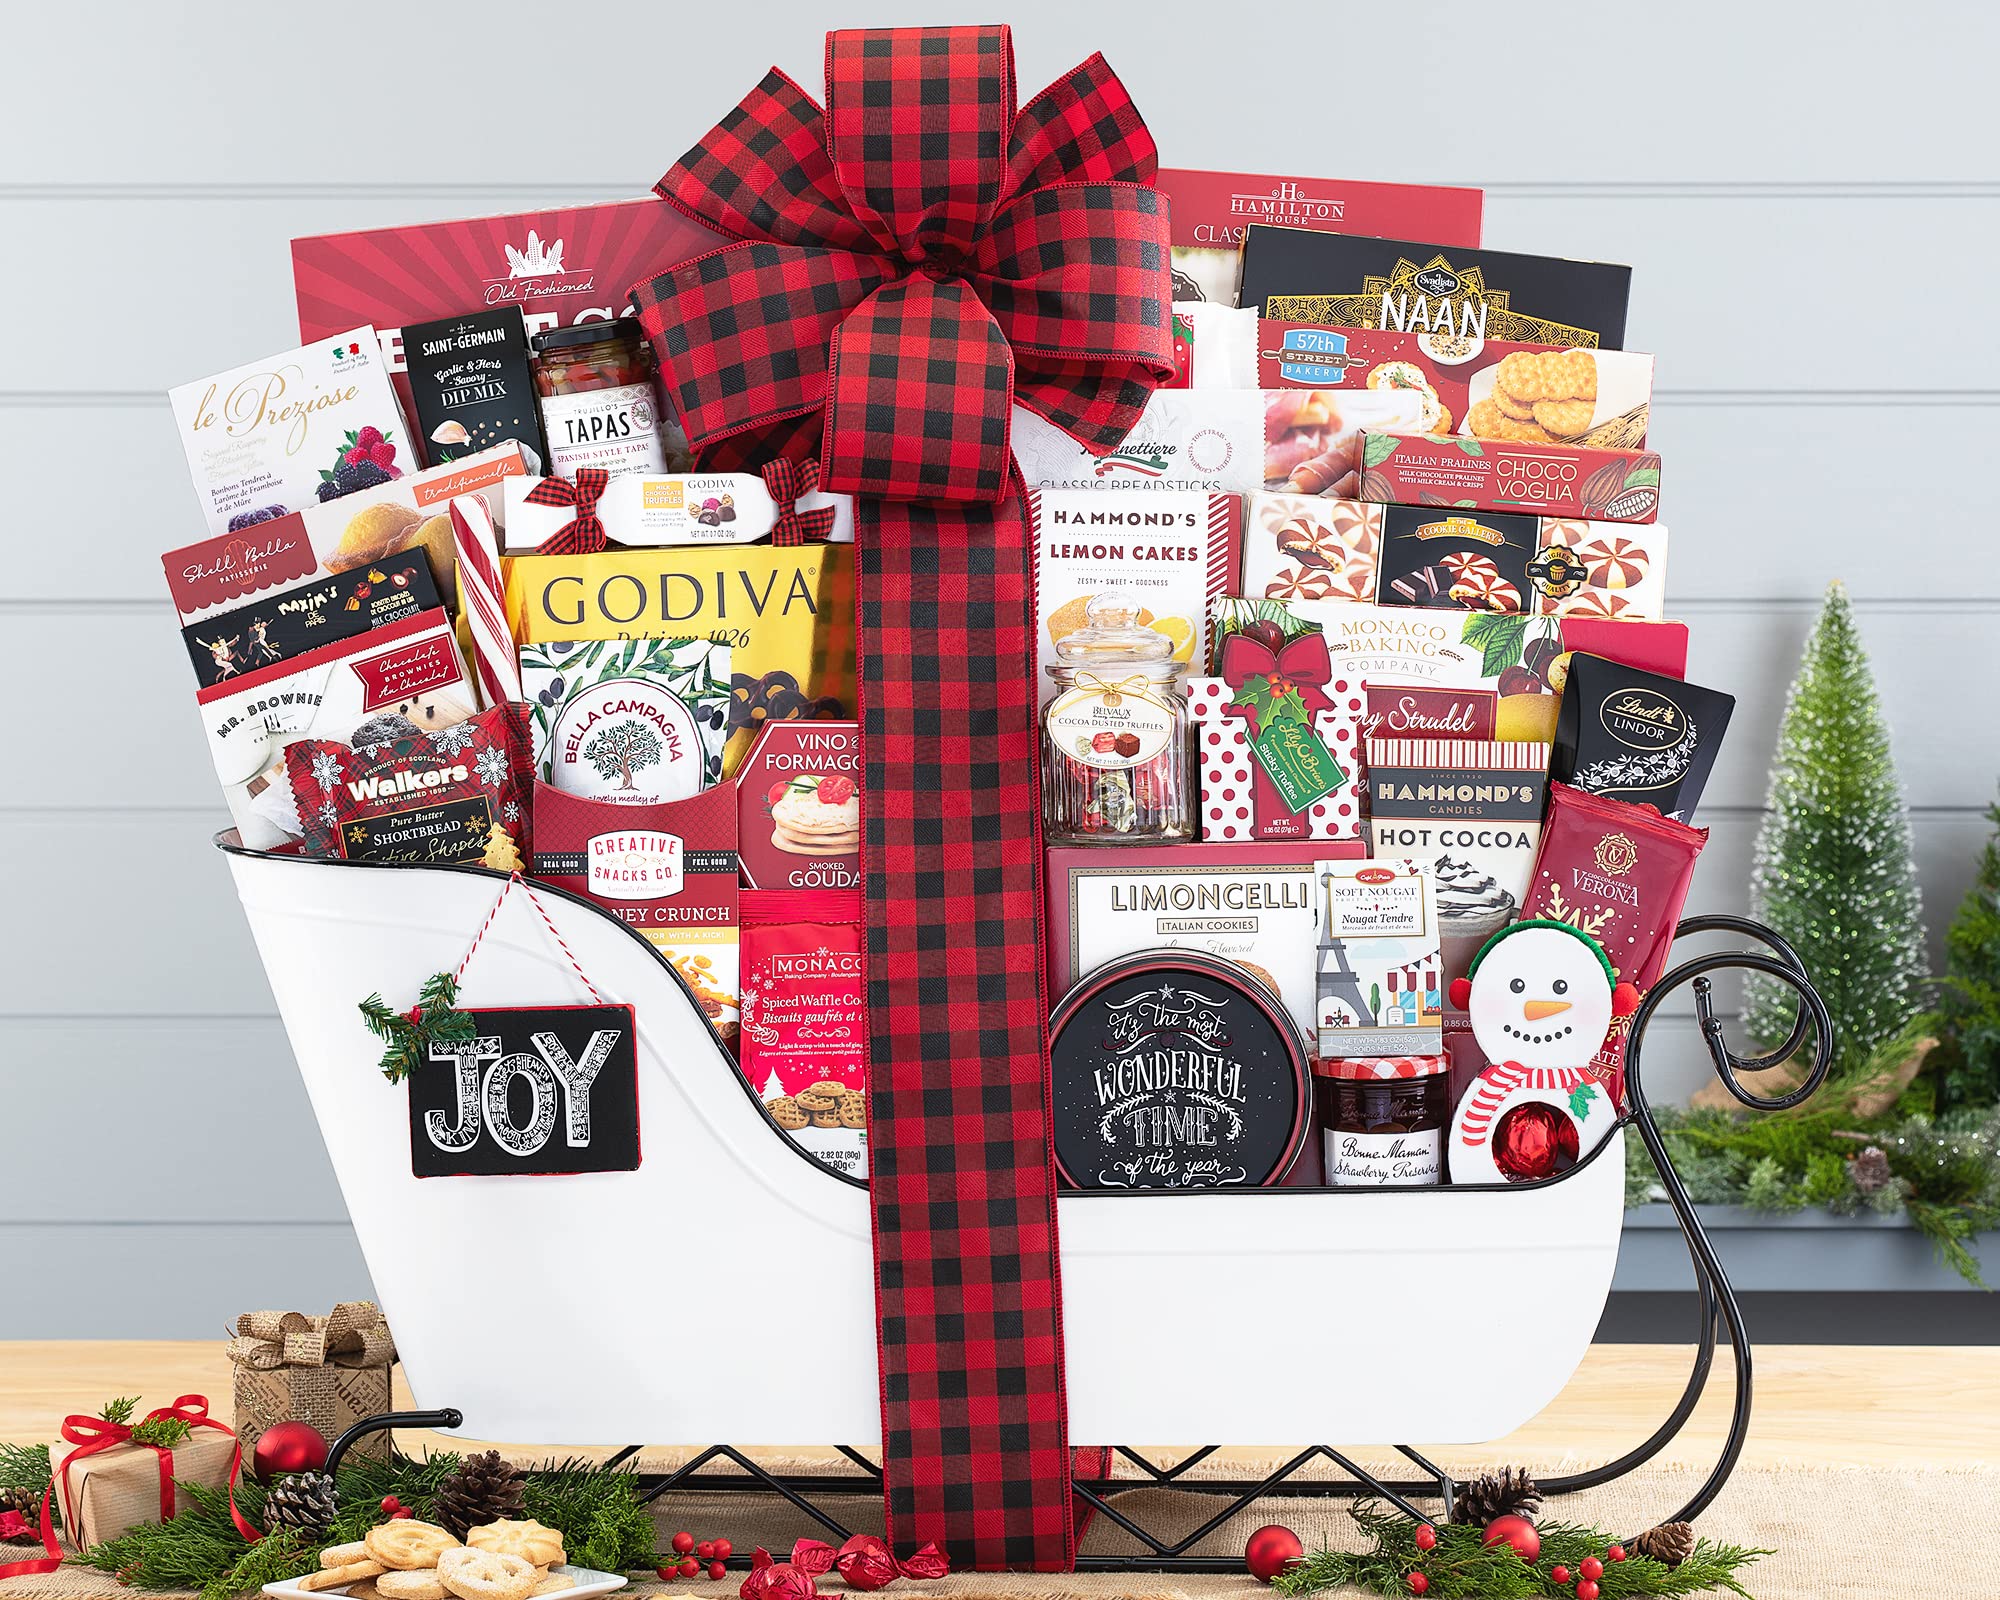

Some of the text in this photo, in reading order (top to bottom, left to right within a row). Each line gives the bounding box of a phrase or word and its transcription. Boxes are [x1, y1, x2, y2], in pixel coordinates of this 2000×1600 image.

[1230, 199, 1345, 219] HAMILTON
[1265, 214, 1308, 225] HOUSE
[484, 276, 595, 305] Old Fashioned
[1381, 290, 1489, 339] NAAN
[422, 327, 507, 356] SAINT-GERMAIN
[1296, 333, 1335, 352] 57th
[1285, 351, 1343, 365] STREET
[433, 357, 502, 384] Garlic Herb
[453, 371, 486, 386] Savory
[1285, 364, 1340, 378] BAKERY
[440, 380, 508, 408] DIP MIX
[193, 364, 360, 457] le Preziose
[573, 403, 619, 415] TRUJILLO'S
[564, 411, 631, 444] TAPAS
[557, 446, 623, 463] SPANISH STYLE
[1394, 454, 1492, 470] ITALIAN PRALINES
[1398, 469, 1486, 482] MILK CHOCOLATE PRALINES
[1495, 458, 1578, 483] CHOCO
[210, 473, 267, 498] Bonbons Tendres
[213, 477, 284, 507] Larôme de Framboise
[687, 478, 736, 490] GODIVA
[1398, 476, 1485, 489] WITH MILK CREAM CRISPS
[1496, 480, 1575, 502] VOGLIA
[645, 489, 683, 497] CHOCOLATE
[646, 495, 684, 505] TRUFFLES
[216, 497, 252, 514] et de Mûre
[1053, 510, 1197, 527] HAMMOND'S
[1423, 525, 1499, 543] COOKIE GALLERY
[183, 538, 299, 585] Shell Bella
[1050, 543, 1199, 562] LEMON CAKES
[1542, 549, 1575, 565] HIGHEST
[219, 563, 269, 585] PATISSERIE
[1077, 576, 1169, 587] ZESTY SWEET GOODNESS
[541, 566, 819, 626] GODIVA
[1540, 580, 1572, 594] QUALITY
[304, 615, 327, 628] PARIS
[307, 610, 320, 620] DE
[1340, 618, 1447, 641] MONACO
[1349, 637, 1438, 658] BAKING
[378, 644, 441, 674] Chocolate
[1345, 659, 1440, 677] COMPANY
[384, 659, 442, 684] BROWNIES
[378, 665, 450, 699] Au Chocolat
[216, 692, 324, 739] MR. BROWNIE
[1092, 705, 1132, 717] BELVAUX
[1387, 696, 1475, 733] Strudel
[1615, 695, 1665, 720] Lindt
[564, 699, 685, 765] BELLA CAMPAGNA
[1058, 717, 1090, 727] COCOA
[1091, 718, 1125, 729] DUSTED
[1126, 720, 1165, 732] TRUFFLES
[1613, 716, 1665, 741] LINDOR
[794, 733, 848, 751] VINO
[364, 756, 448, 777] PRODUCT OF SCOTLAND
[1258, 743, 1281, 773] Sticky
[1278, 770, 1299, 801] Toffee
[345, 763, 469, 802] Walkers
[374, 790, 428, 808] ESTABLISHED
[649, 794, 660, 804] of
[1378, 782, 1534, 804] HAMMOND'S
[390, 809, 445, 828] Pure Butter
[1428, 805, 1483, 816] CANDIES
[373, 820, 462, 847] SHORTBREAD
[1379, 828, 1432, 847] HOT
[1438, 830, 1532, 849] COCOA
[425, 834, 489, 862] Shapes
[594, 836, 677, 856] CREATIVE
[542, 859, 579, 869] REAL GOOD
[692, 857, 728, 867] FEEL GOOD
[808, 861, 846, 871] SMOKED
[594, 866, 678, 882] SNACKS CO.
[788, 870, 860, 888] GOUDA
[1587, 871, 1633, 890] CIOCCOLATERIA
[1111, 882, 1308, 912] LIMONCELLI
[1335, 887, 1418, 897] SOFT NOUGAT
[1571, 867, 1640, 908] VERONA
[653, 906, 731, 922] CRUNCH
[1341, 912, 1414, 926] Nougat Tendre
[1161, 919, 1254, 931] ITALIAN COOKIES
[668, 930, 725, 940] WITH A KICK!
[1206, 938, 1256, 954] Flavored
[784, 973, 802, 981] Baking
[802, 972, 828, 981] Company
[762, 993, 841, 1010] Spiced Waffle
[761, 1012, 802, 1024] Biscuits
[804, 1007, 843, 1026] gaufrés
[845, 1011, 856, 1021] et
[1107, 999, 1228, 1043] it's the most
[1443, 1019, 1461, 1028] 0.85
[798, 1043, 813, 1051] crisp
[1377, 1045, 1393, 1053] NET
[1393, 1043, 1408, 1053] 52g
[520, 1055, 551, 1082] HEAVEN
[1093, 1049, 1247, 1107] WONDERFUL
[424, 1030, 622, 1157] JOY
[1122, 1104, 1219, 1149] TIME
[820, 1151, 835, 1160] 2.82
[835, 1151, 844, 1159] OZ
[844, 1150, 861, 1161] (80g)
[1341, 1136, 1430, 1159] Bonne Maman
[1112, 1148, 1232, 1185] of the year
[1332, 1158, 1440, 1184] Strawberry Preserves
